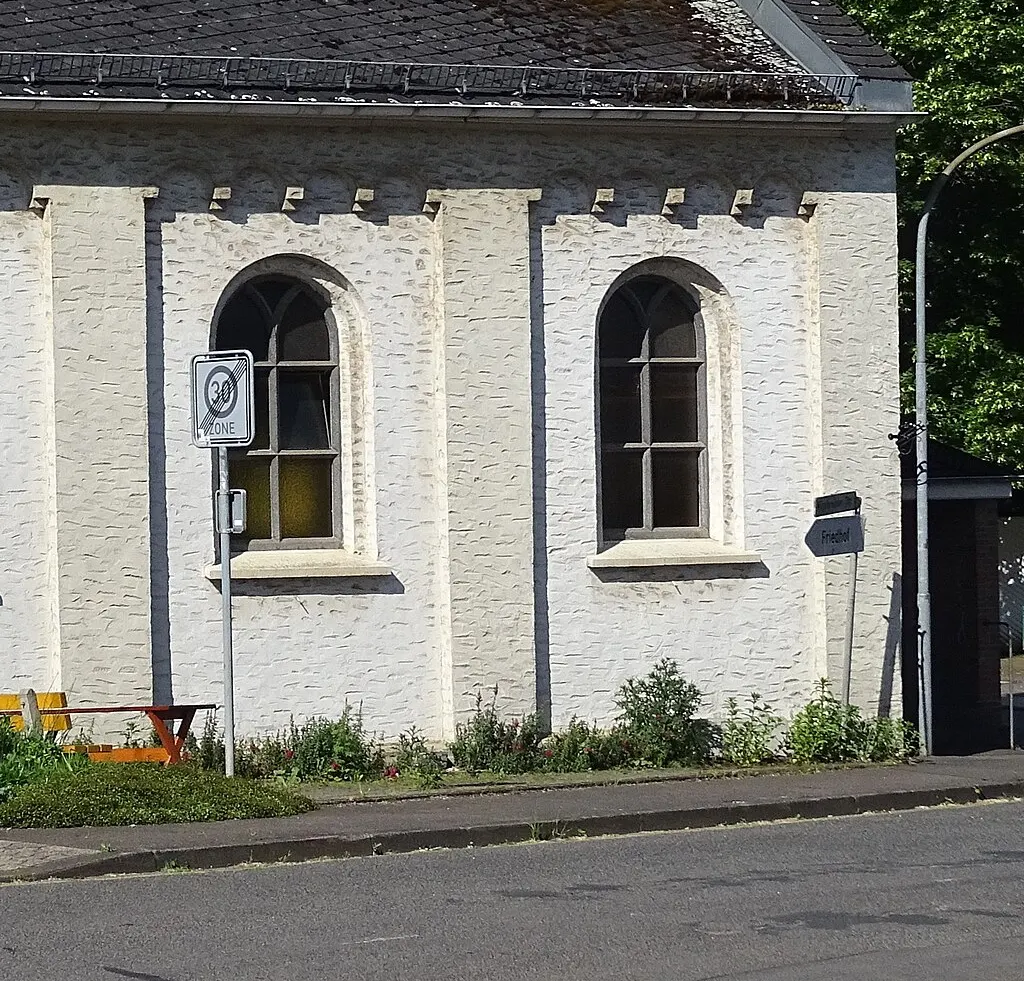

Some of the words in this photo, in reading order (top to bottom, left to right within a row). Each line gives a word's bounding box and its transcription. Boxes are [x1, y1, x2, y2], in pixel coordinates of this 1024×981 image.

[211, 380, 231, 404] 30
[209, 421, 235, 435] ZONE
[821, 527, 850, 544] Friedhof
